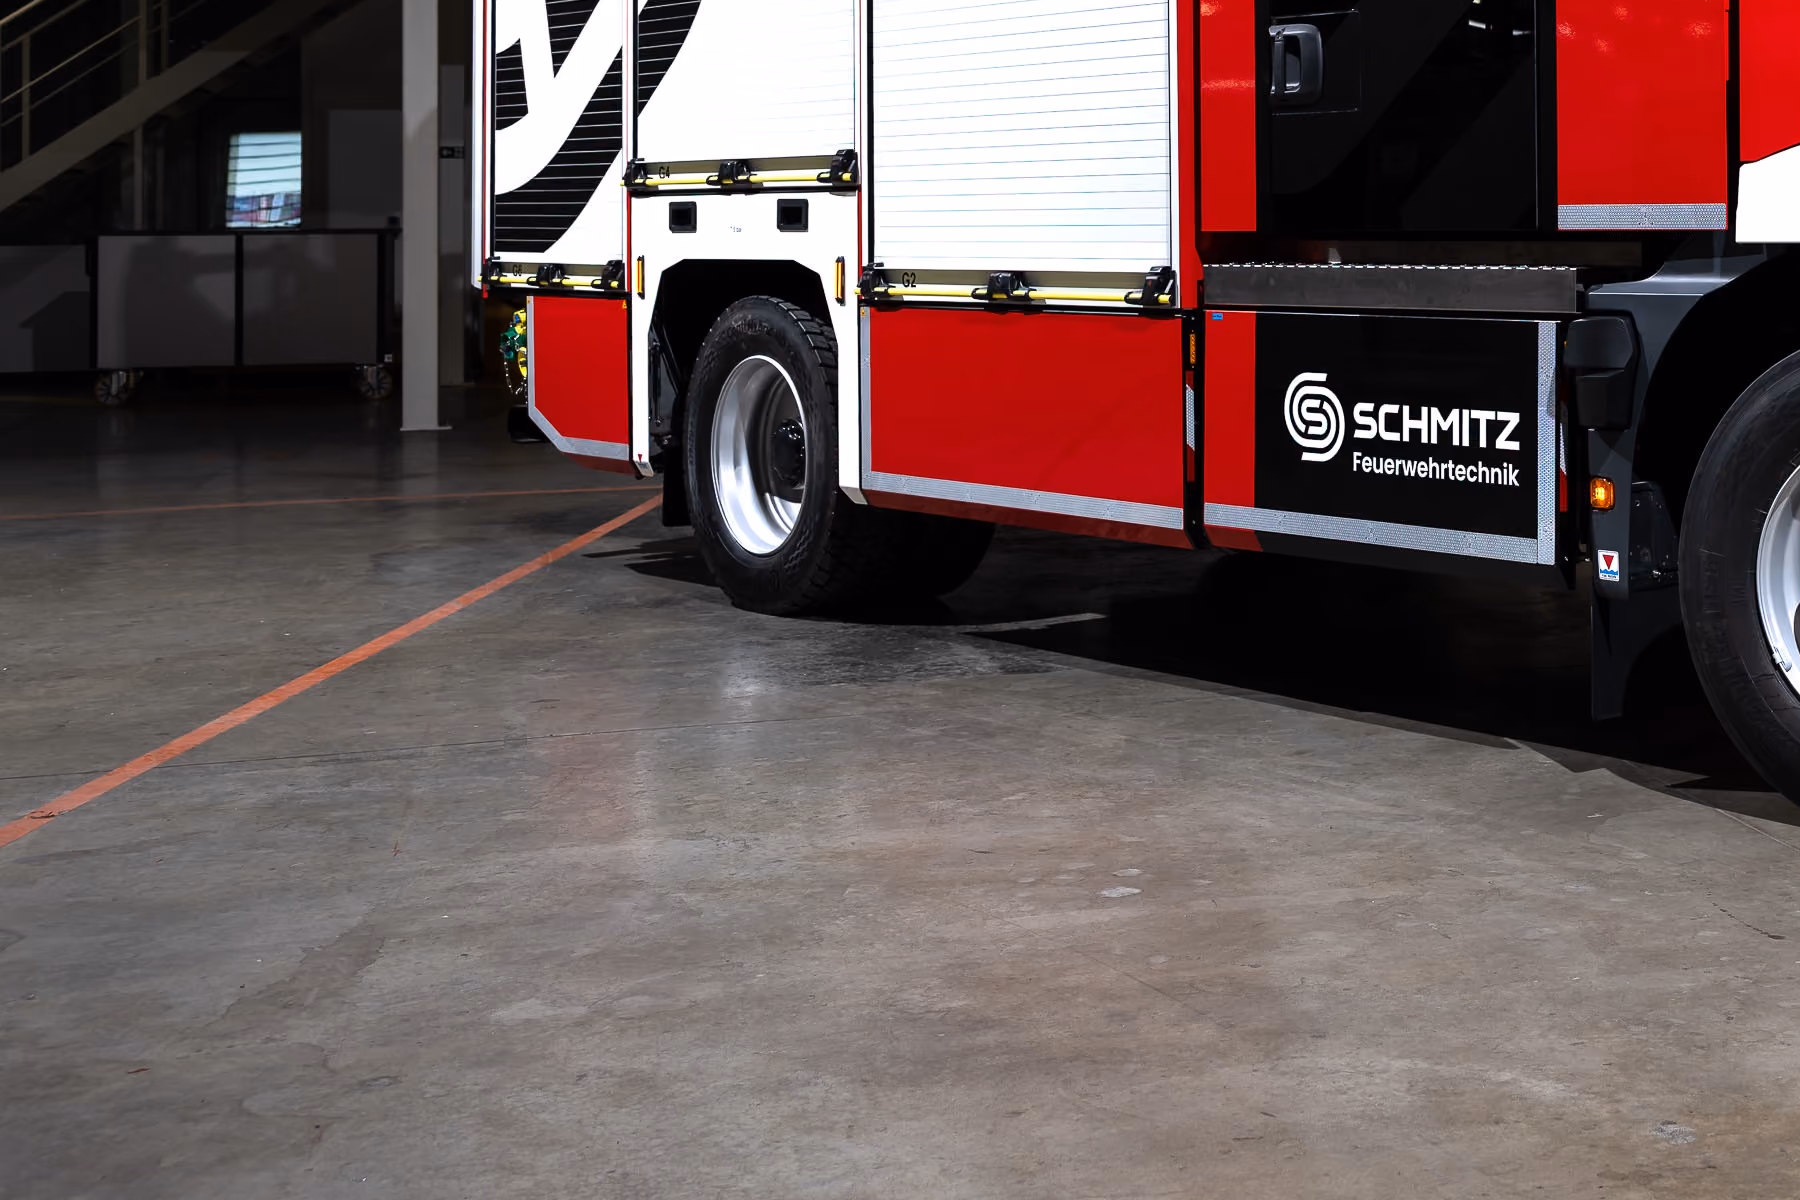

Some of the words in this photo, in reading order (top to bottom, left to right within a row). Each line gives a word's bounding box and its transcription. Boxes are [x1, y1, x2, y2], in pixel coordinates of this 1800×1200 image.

[658, 166, 670, 179] G4
[902, 271, 916, 288] G2
[1353, 402, 1521, 451] SCHMITZ
[1352, 452, 1520, 487] Feuerwehrtechnik
